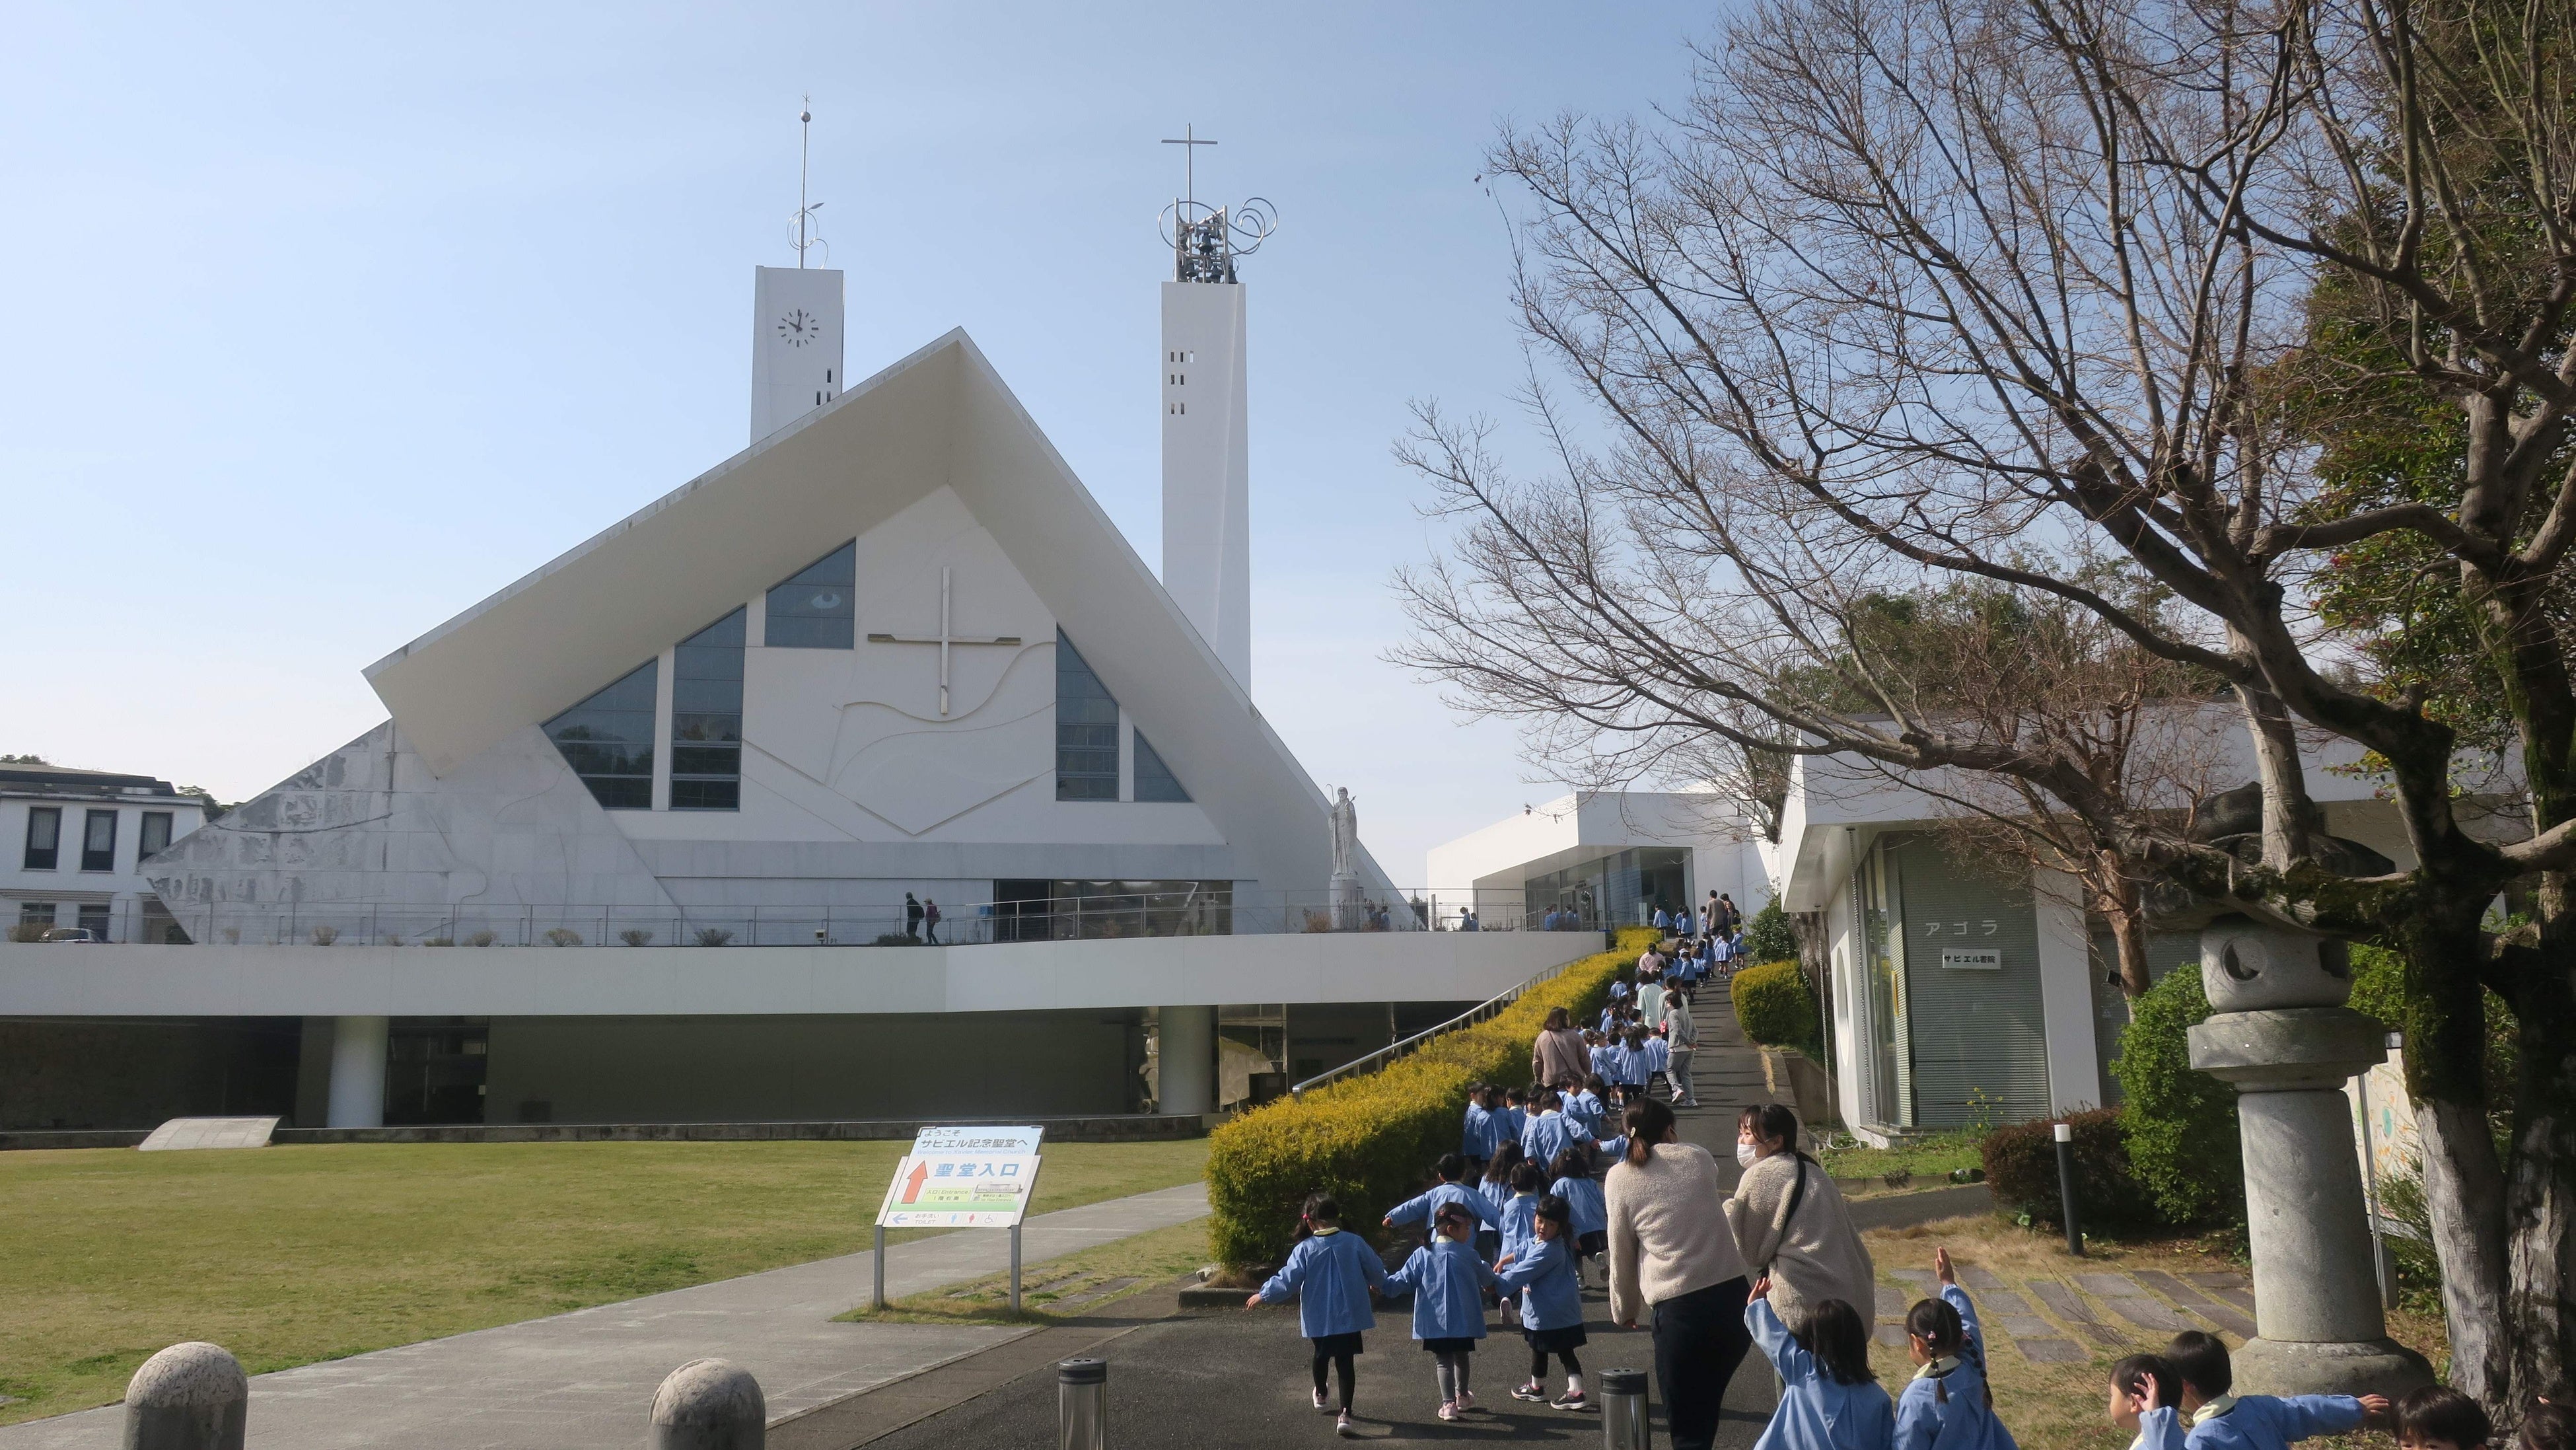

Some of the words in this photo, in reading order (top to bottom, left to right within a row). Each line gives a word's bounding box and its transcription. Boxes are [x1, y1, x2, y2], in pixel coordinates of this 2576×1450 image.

[1925, 920, 1997, 937] アゴラ
[921, 1138, 1028, 1148] サビエル記念聖堂へ
[934, 1163, 1020, 1177] 聖堂入口
